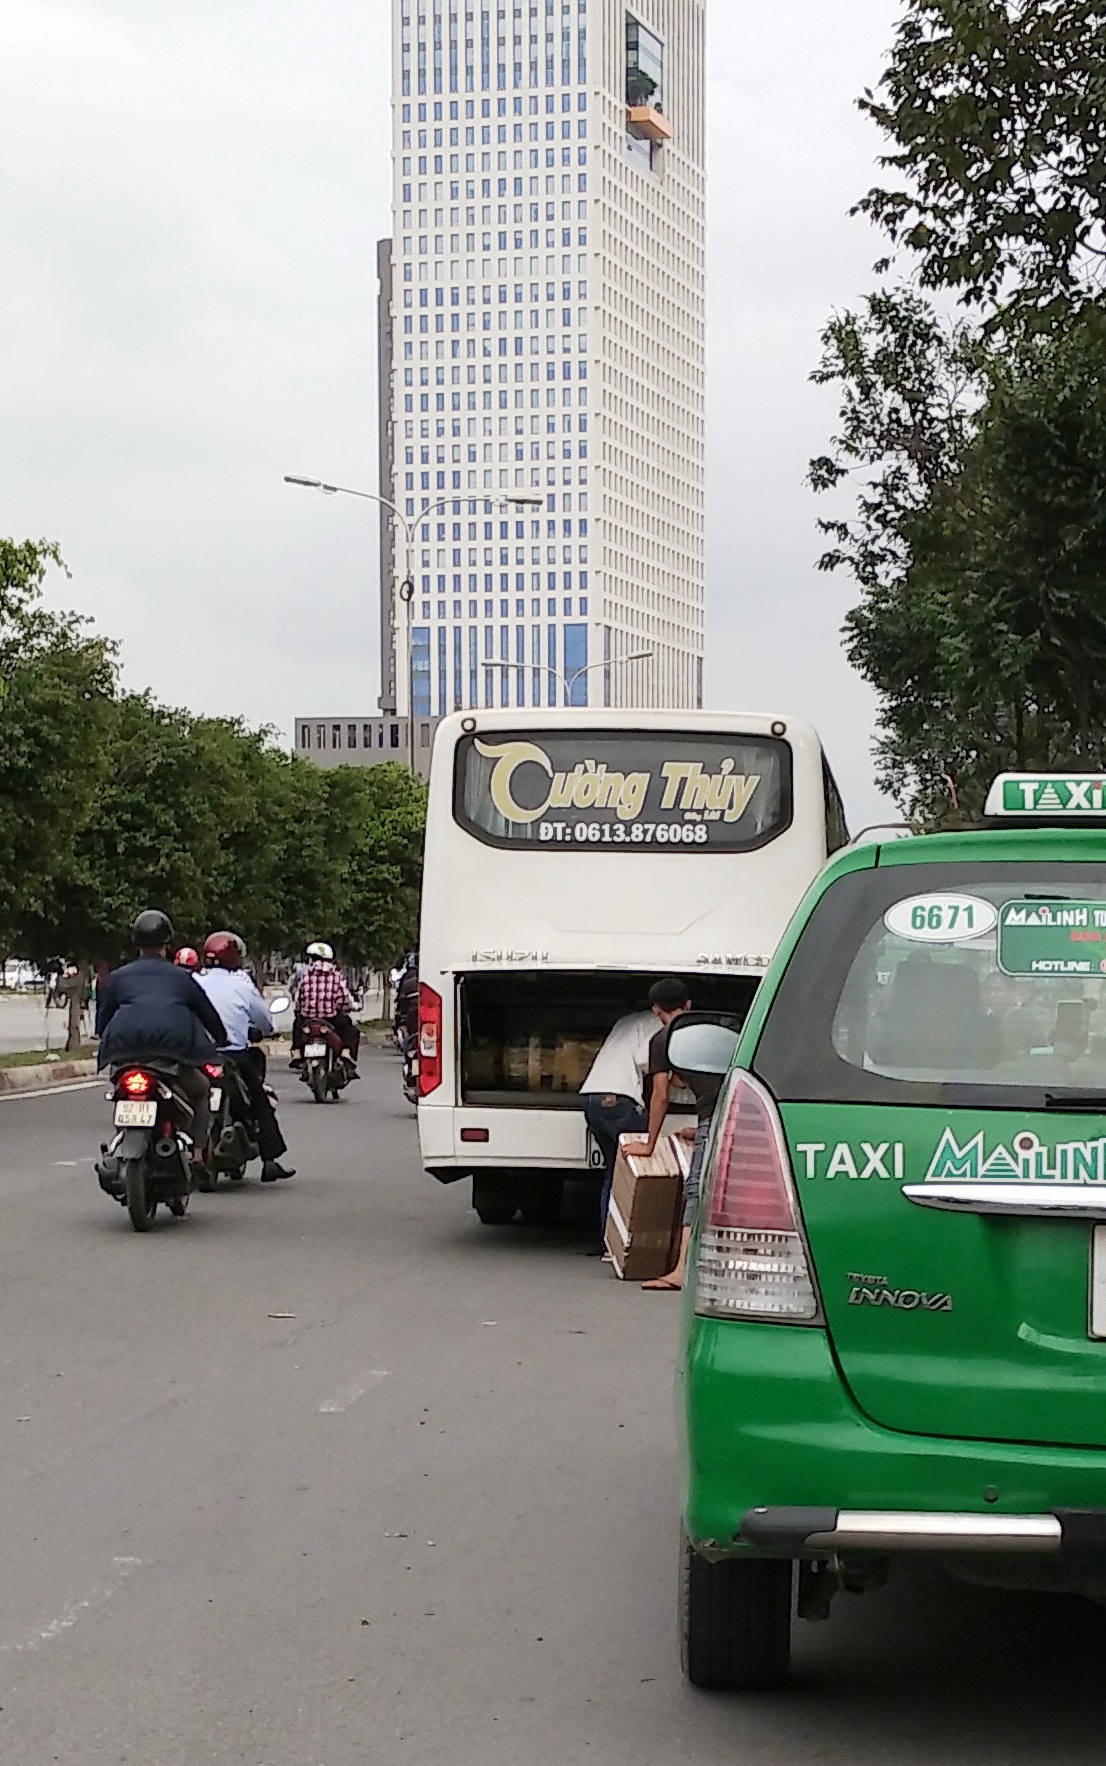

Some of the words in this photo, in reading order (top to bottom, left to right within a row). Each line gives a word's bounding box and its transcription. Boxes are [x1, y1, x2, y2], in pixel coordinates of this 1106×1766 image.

[474, 737, 651, 823] Cường
[660, 758, 761, 822] Thủy
[538, 821, 572, 842] ĐT:
[577, 822, 708, 843] 0613.876068
[911, 904, 974, 930] 6671
[796, 1142, 904, 1180] TAXI
[848, 1286, 953, 1312] INNOVA
